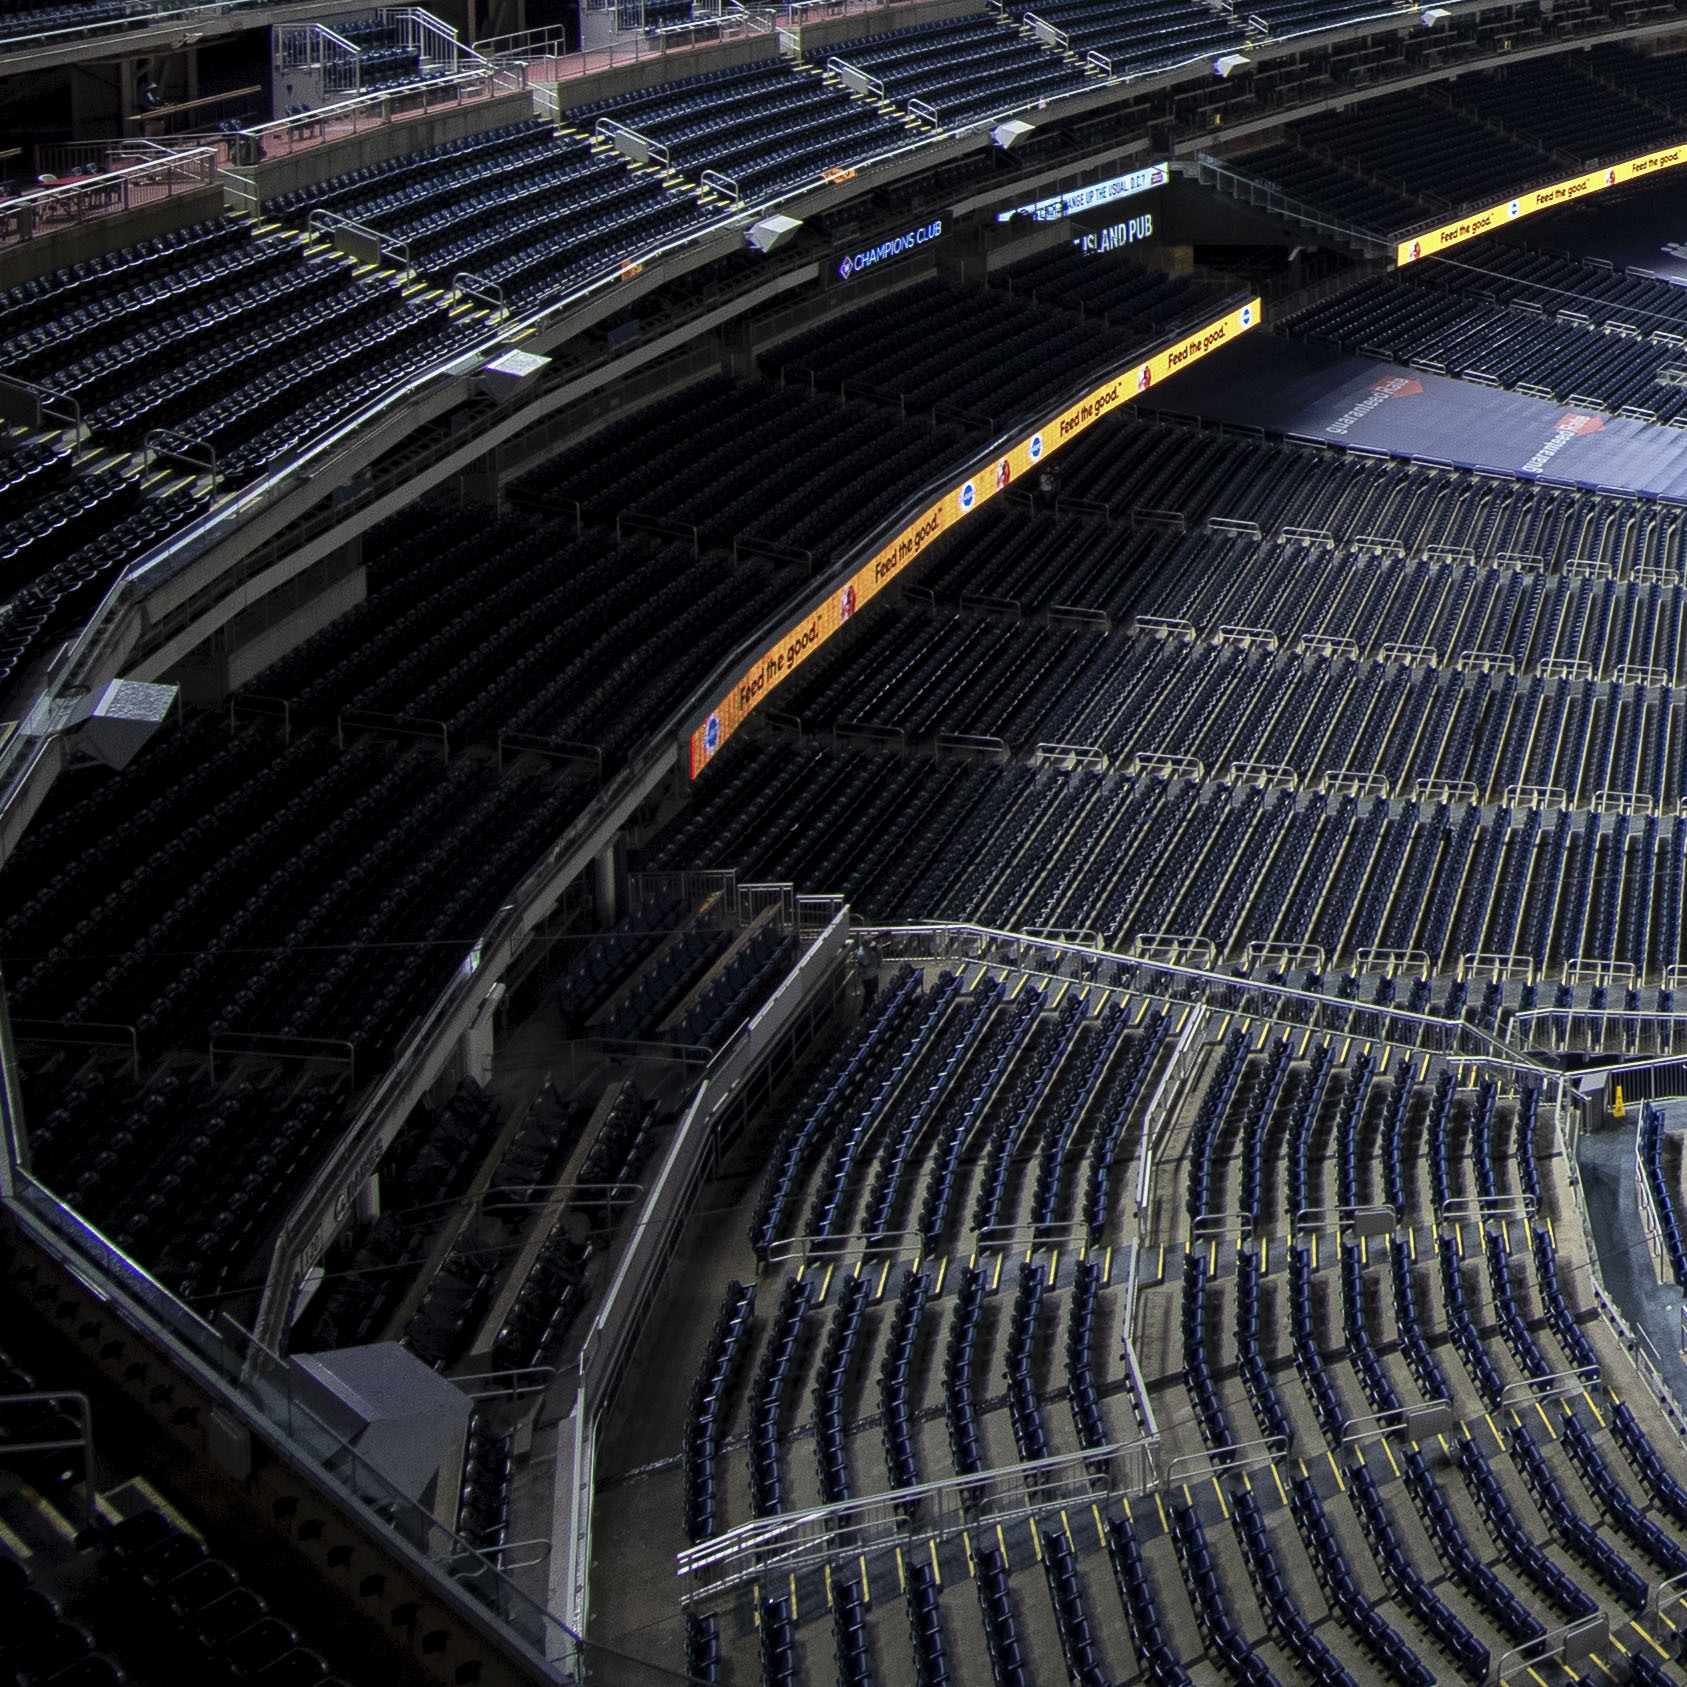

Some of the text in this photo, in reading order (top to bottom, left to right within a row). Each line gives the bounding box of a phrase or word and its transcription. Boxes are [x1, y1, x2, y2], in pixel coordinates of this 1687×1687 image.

[854, 221, 942, 270] CHAMPIONS CLUB
[1130, 214, 1152, 243] PUB
[739, 671, 764, 711] Feed
[766, 654, 784, 679] the
